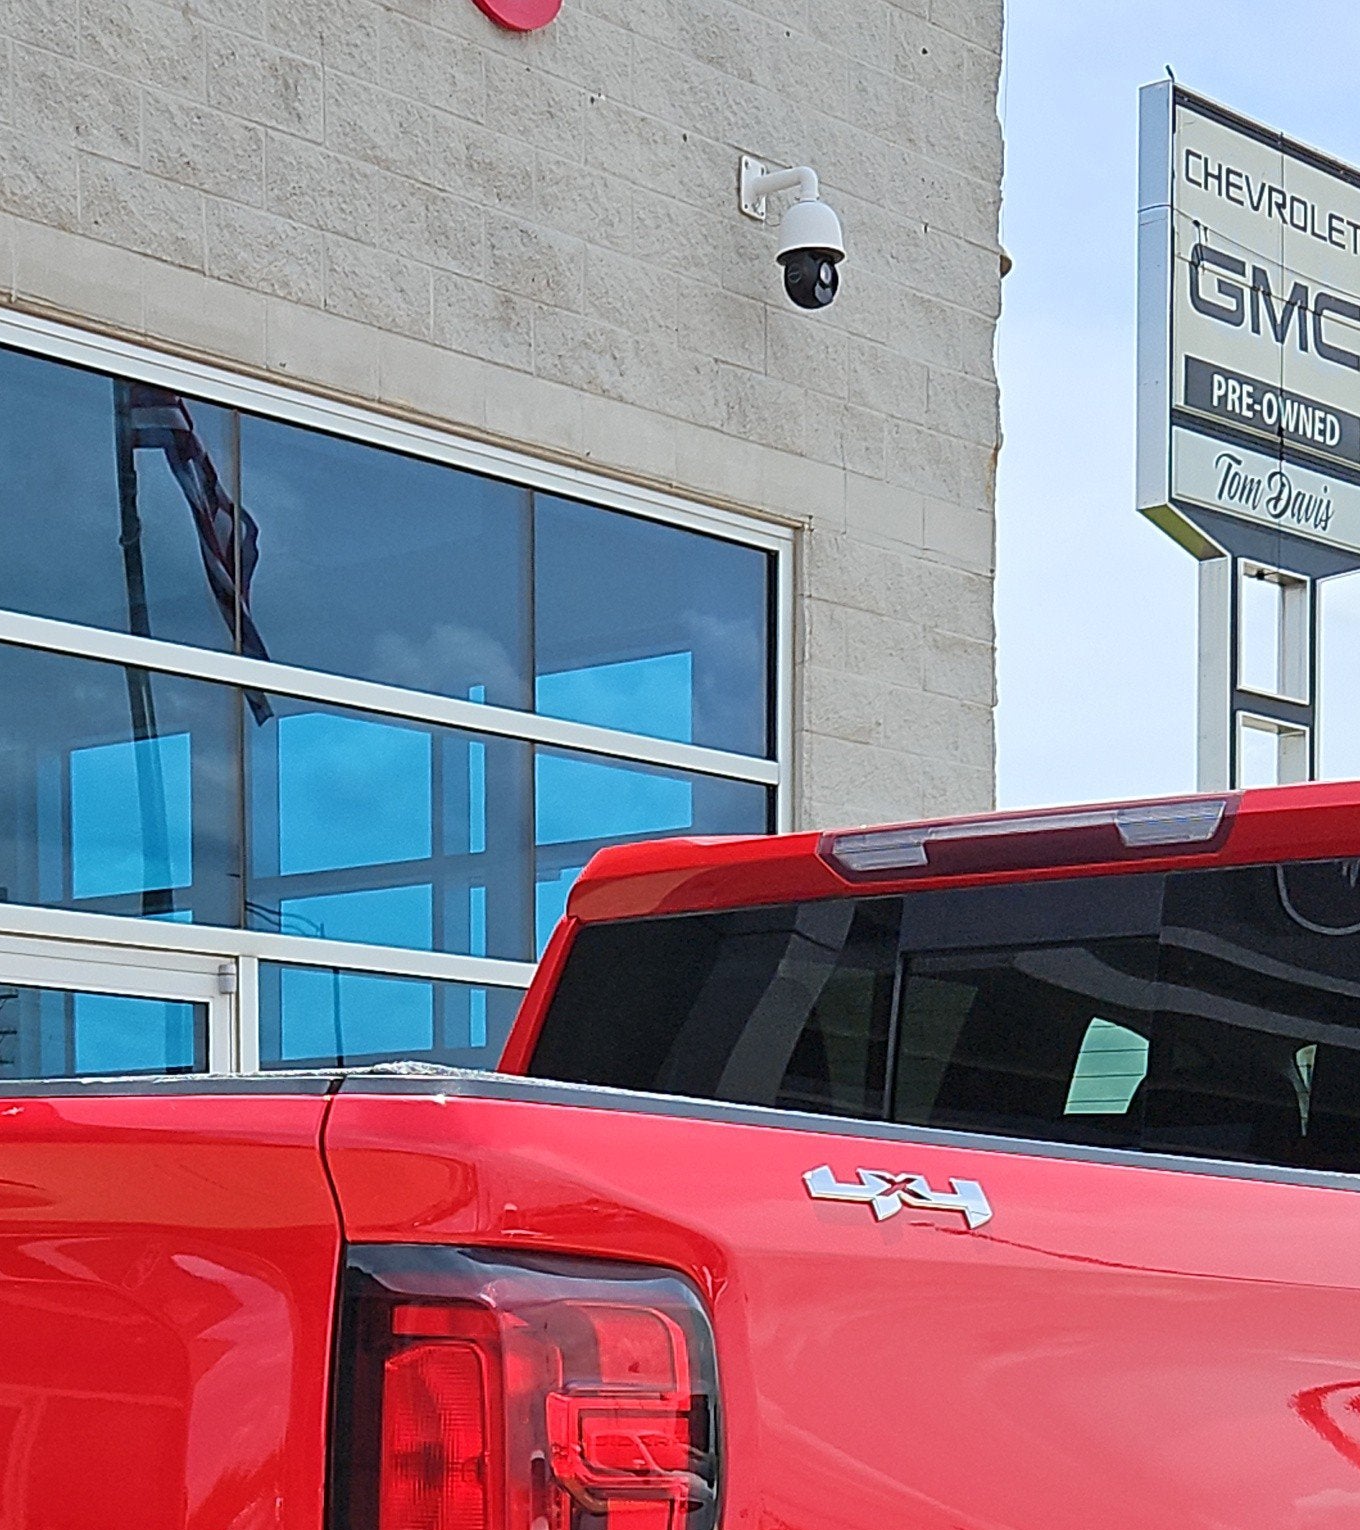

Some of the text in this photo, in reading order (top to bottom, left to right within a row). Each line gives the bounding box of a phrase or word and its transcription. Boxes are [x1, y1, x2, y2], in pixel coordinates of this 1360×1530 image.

[1211, 372, 1341, 449] PRE-OWNED
[1214, 452, 1336, 531] Tom Davis
